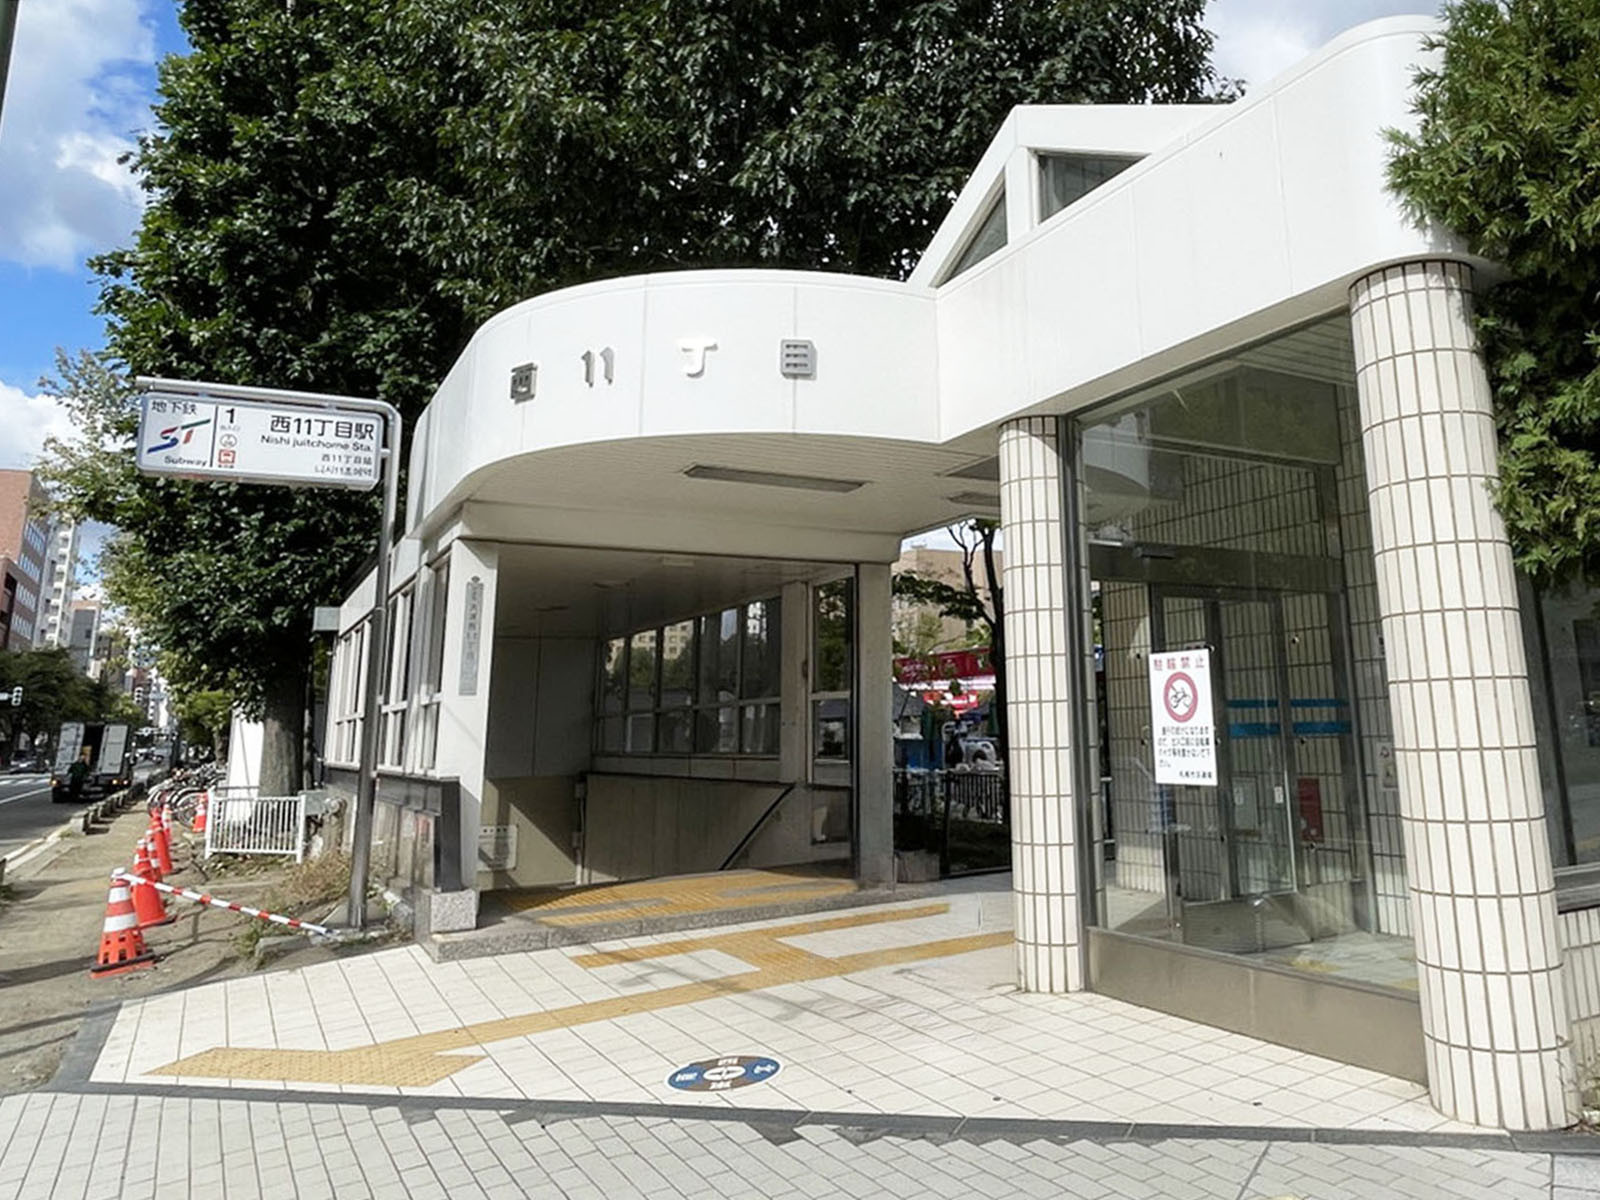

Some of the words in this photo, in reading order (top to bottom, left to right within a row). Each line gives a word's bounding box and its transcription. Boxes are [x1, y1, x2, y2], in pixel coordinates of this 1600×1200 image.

[151, 400, 197, 415] 地下鉄
[226, 408, 235, 423] 1
[270, 415, 375, 440] 西11丁目駅
[261, 435, 290, 444] Nishi
